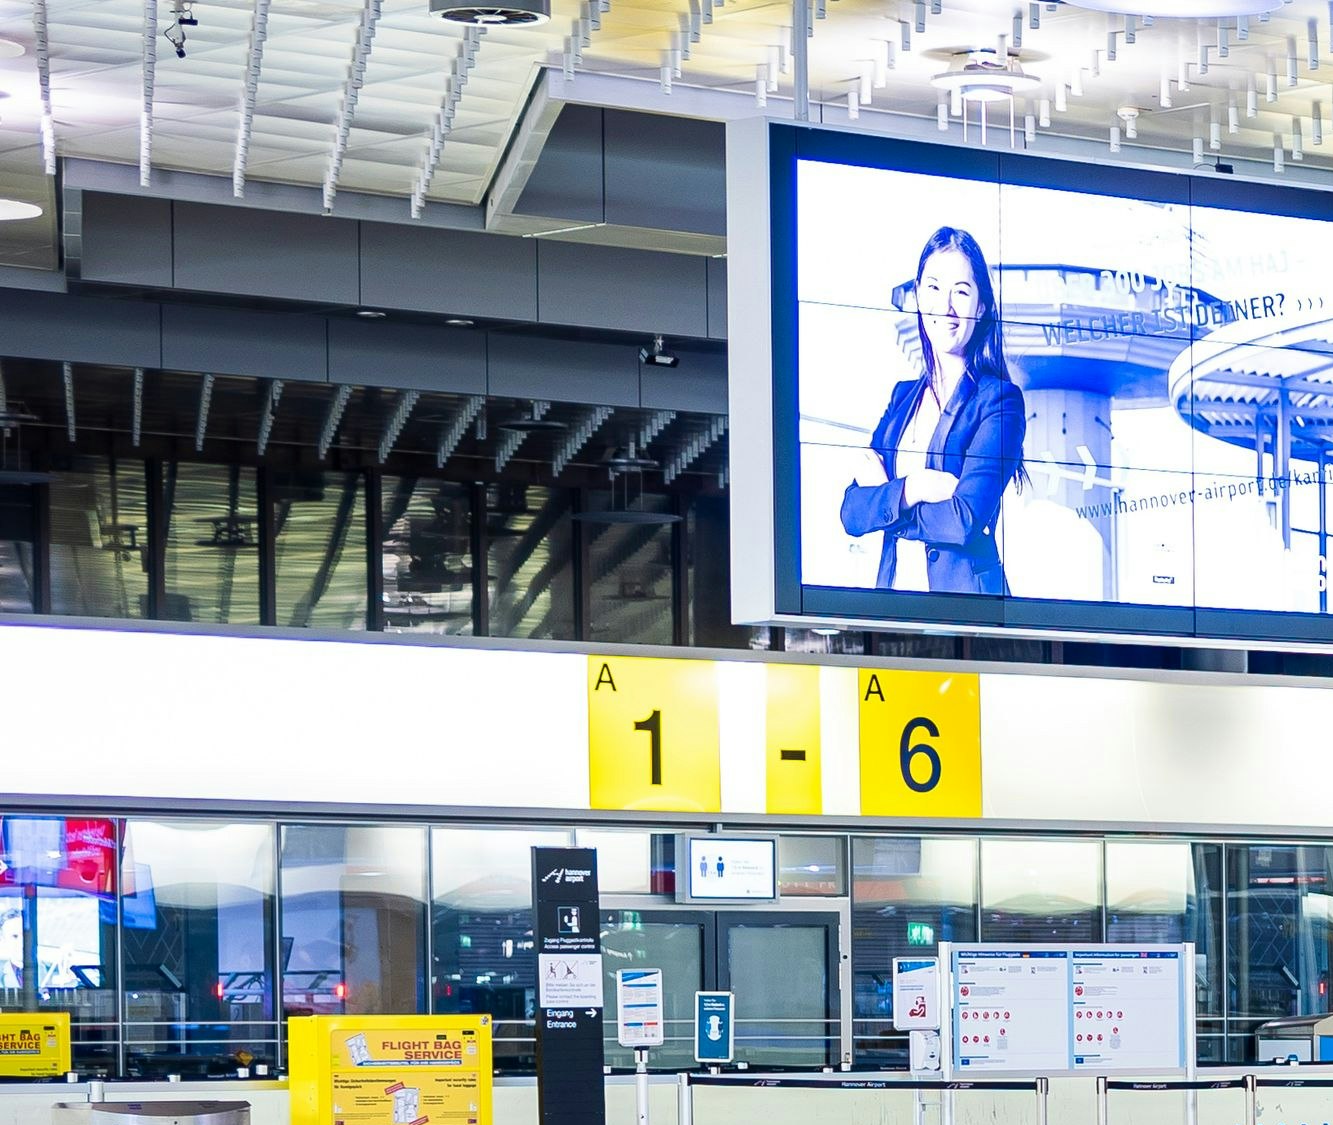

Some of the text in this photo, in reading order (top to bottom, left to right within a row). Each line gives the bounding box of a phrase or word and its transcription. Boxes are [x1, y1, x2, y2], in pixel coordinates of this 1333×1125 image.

[1042, 293, 1286, 346] WELCHER IST DEINER?
[594, 664, 618, 692] A
[864, 675, 886, 702] A
[634, 709, 662, 785] 1
[899, 717, 942, 793] 6
[564, 868, 592, 877] hannover
[564, 875, 585, 883] airport
[546, 1009, 574, 1019] Eingang
[546, 1020, 578, 1029] Entrance
[382, 1041, 462, 1050] FLIGHT BAG
[404, 1050, 462, 1060] SERVICE
